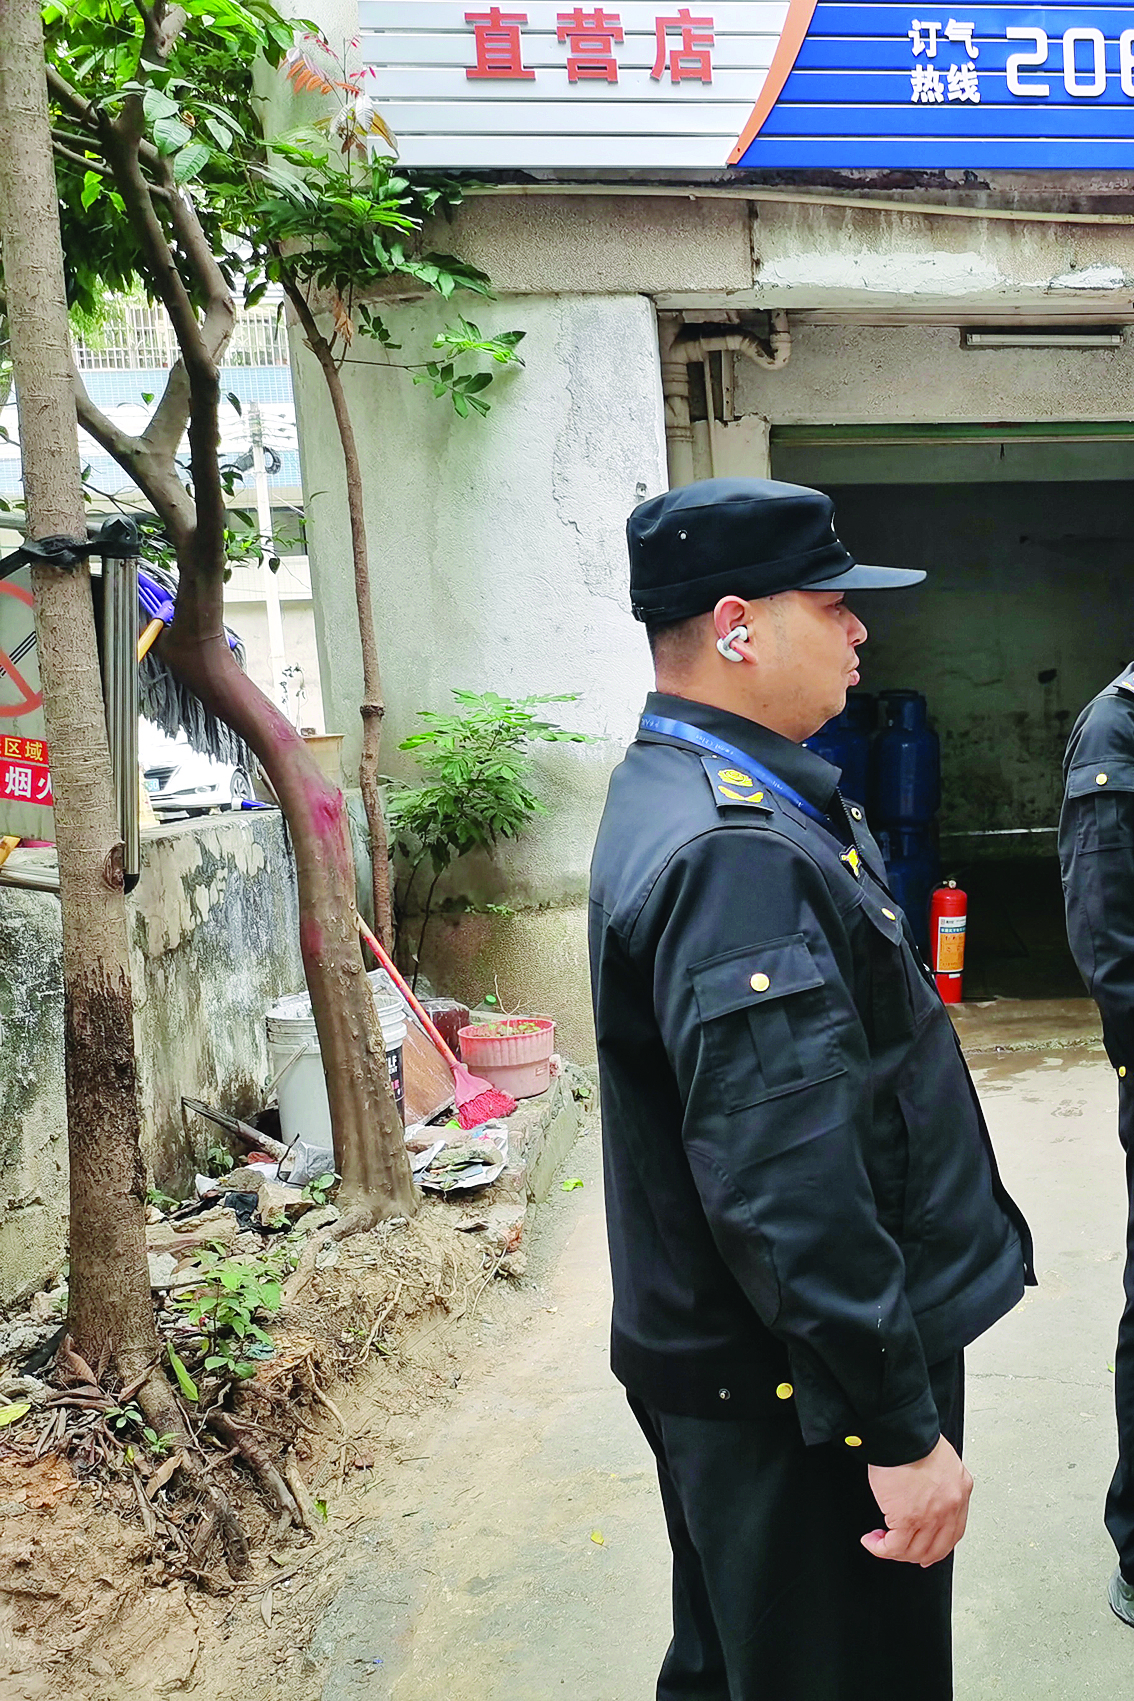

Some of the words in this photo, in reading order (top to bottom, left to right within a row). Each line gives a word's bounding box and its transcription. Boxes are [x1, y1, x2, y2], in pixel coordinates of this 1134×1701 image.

[465, 7, 715, 86] 直营店
[908, 18, 979, 58] 订气
[910, 62, 980, 103] 热线
